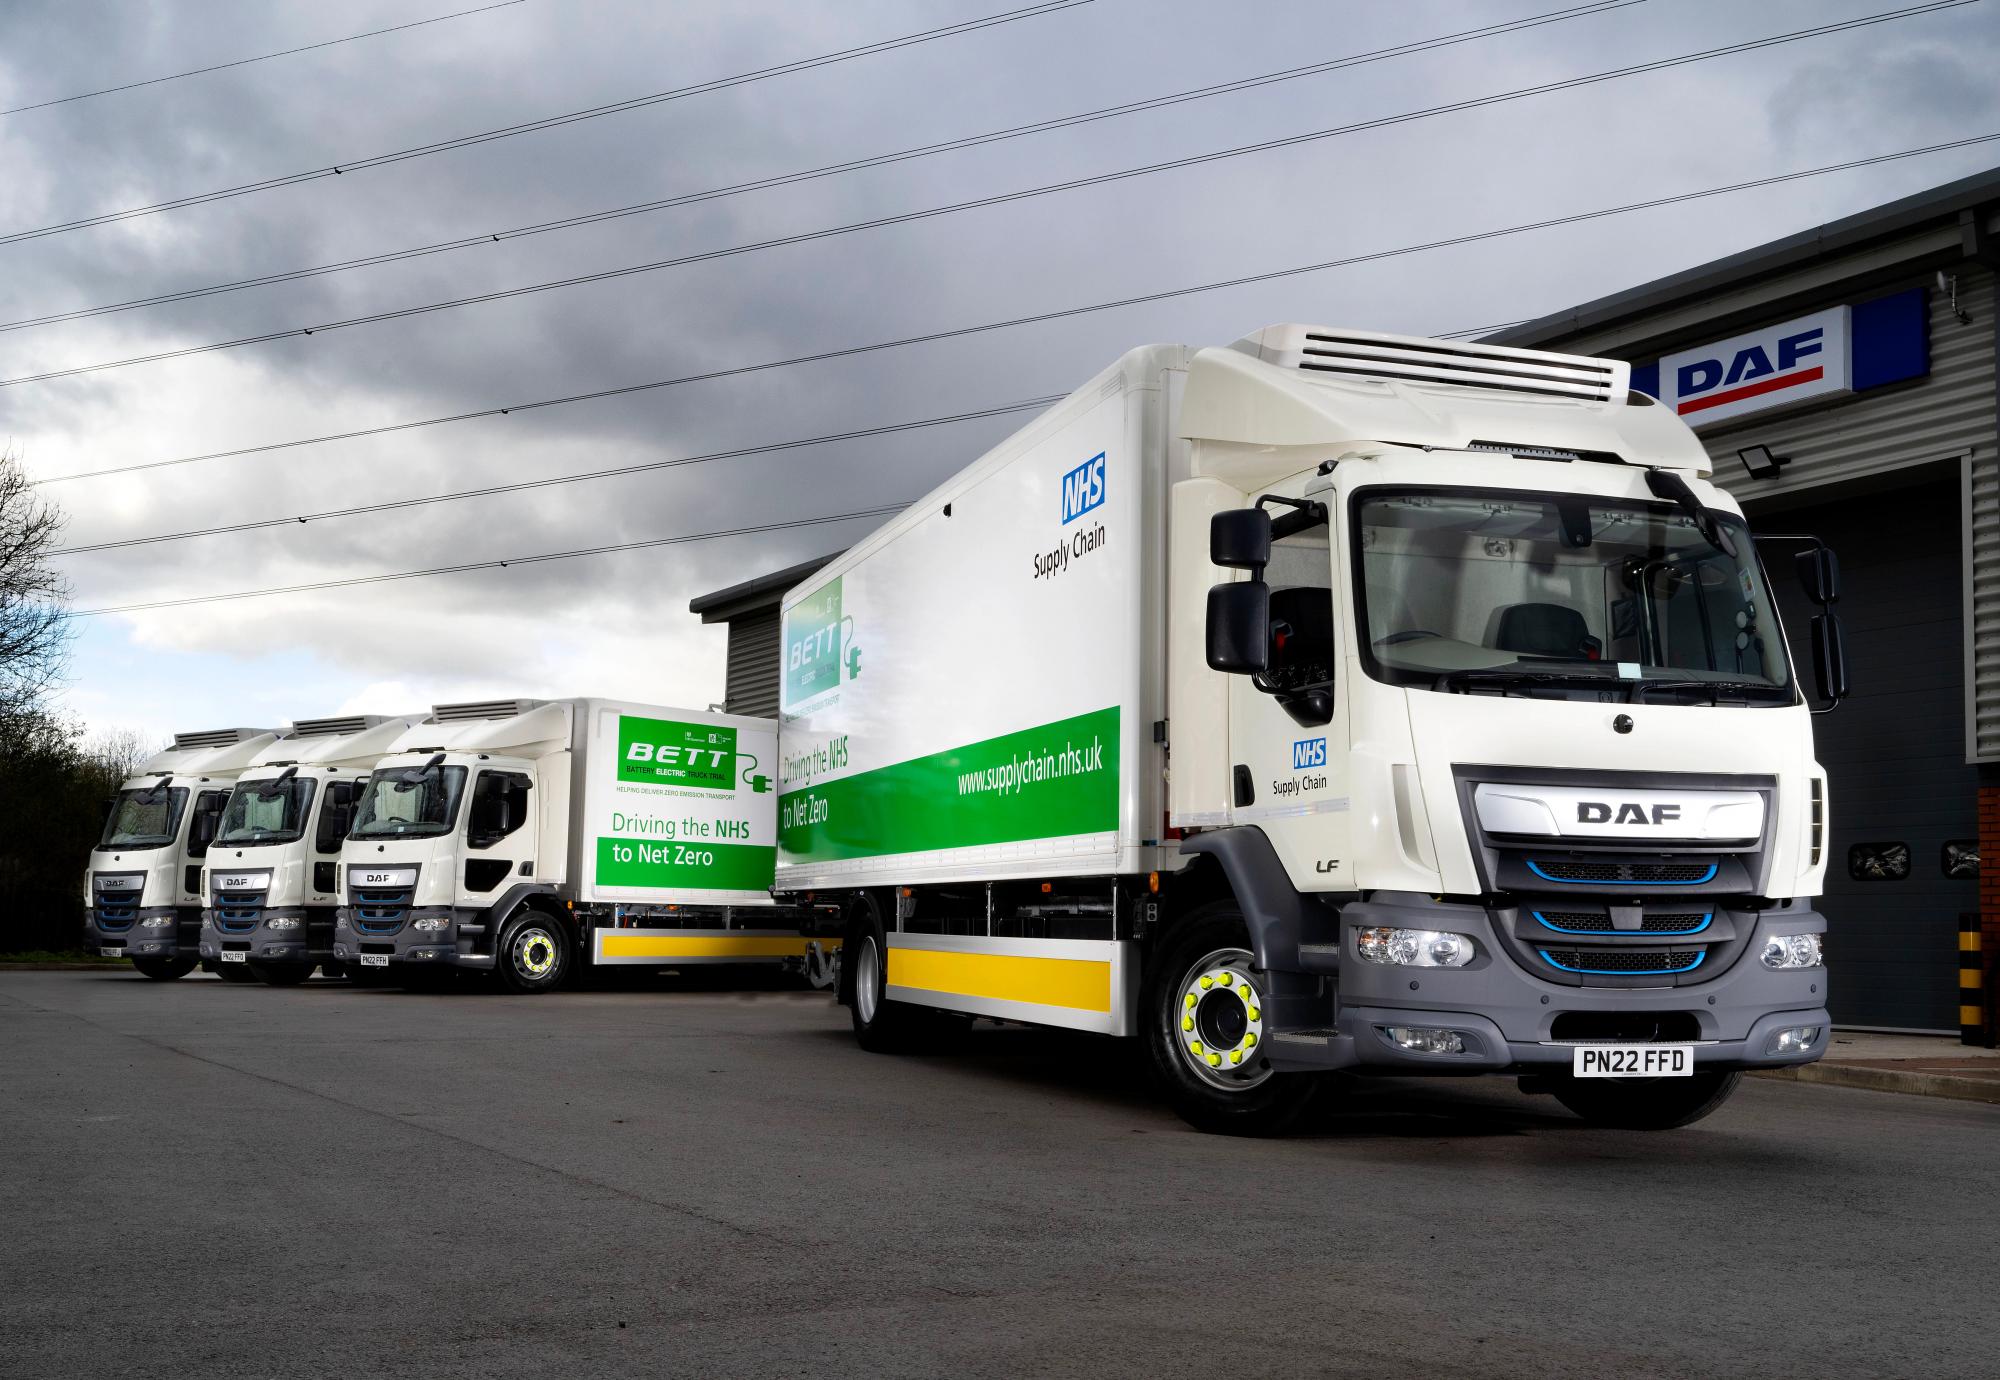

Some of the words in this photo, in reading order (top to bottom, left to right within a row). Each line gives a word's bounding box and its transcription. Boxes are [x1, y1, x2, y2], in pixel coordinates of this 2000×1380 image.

[1677, 327, 1823, 398] DAF
[1063, 456, 1104, 521] NHS
[1034, 539, 1070, 580] Supply
[1073, 520, 1105, 558] Chain
[790, 622, 837, 672] BETT
[626, 742, 728, 768] BETT
[784, 751, 811, 786] Driving
[812, 744, 827, 775] the
[829, 735, 848, 770] NHS
[1294, 739, 1325, 767] NHS
[626, 766, 654, 774] BATTERY
[656, 768, 686, 777] ELECTRIC
[688, 770, 708, 779] TRUCK
[709, 772, 726, 780] TRIAL
[958, 735, 1103, 796] www.supplychain.nhs.uk
[680, 790, 705, 798] EMISSION
[705, 792, 735, 800] TRANSPORT
[1273, 777, 1300, 797] Supply
[1302, 774, 1327, 790] Chain
[784, 803, 792, 830] to
[794, 798, 807, 827] Net
[809, 794, 828, 824] Zero
[1577, 802, 1681, 825] DAF
[612, 812, 676, 840] Driving
[682, 816, 710, 837] the
[715, 820, 750, 839] NHS
[612, 843, 632, 863] to
[638, 844, 670, 864] Net
[674, 846, 713, 866] Zero
[1316, 860, 1340, 873] LF
[226, 878, 248, 886] DAF
[366, 874, 390, 882] DAF
[362, 956, 375, 964] PN22
[1583, 1050, 1638, 1072] PN22
[1644, 1050, 1684, 1072] FFD
